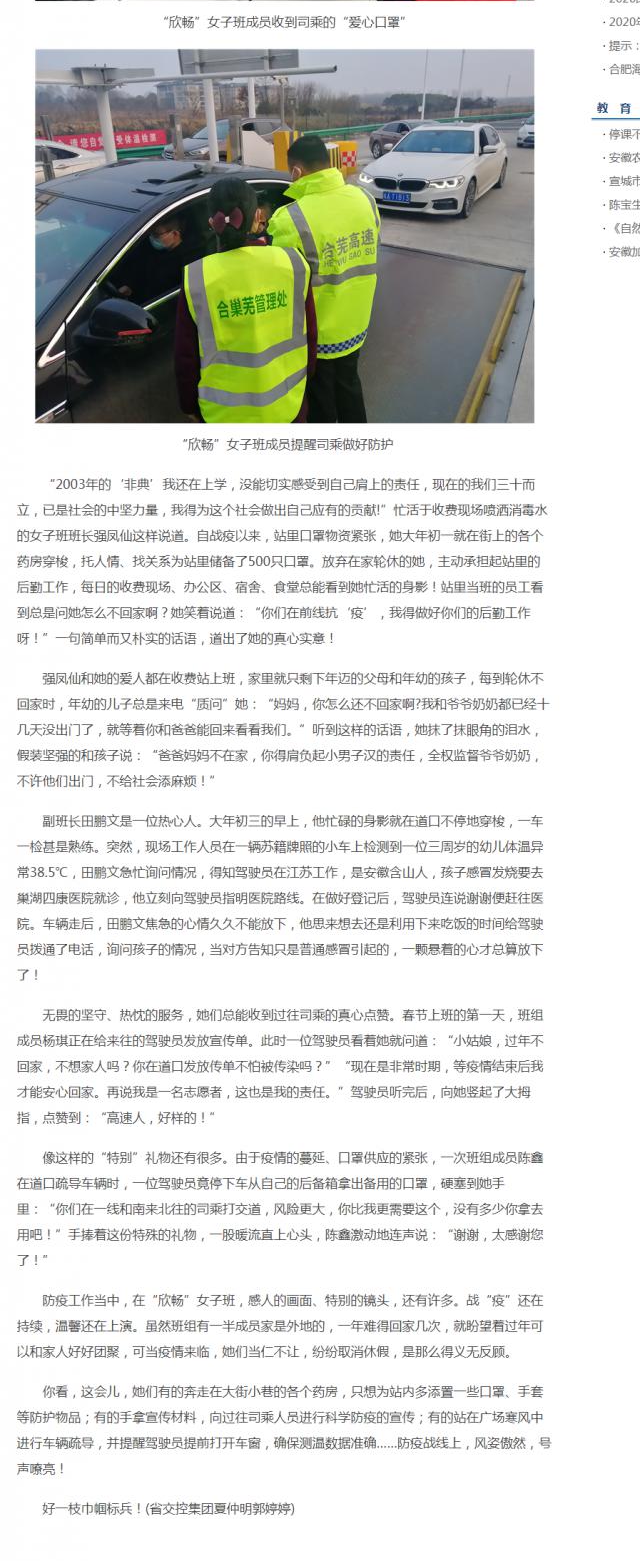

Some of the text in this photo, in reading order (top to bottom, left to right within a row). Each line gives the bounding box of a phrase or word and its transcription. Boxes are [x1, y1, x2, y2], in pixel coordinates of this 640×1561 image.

[217, 290, 287, 319] 合巢芜管理处
[183, 437, 394, 452] “欣畅”女子班成员提醒司乘做好防护
